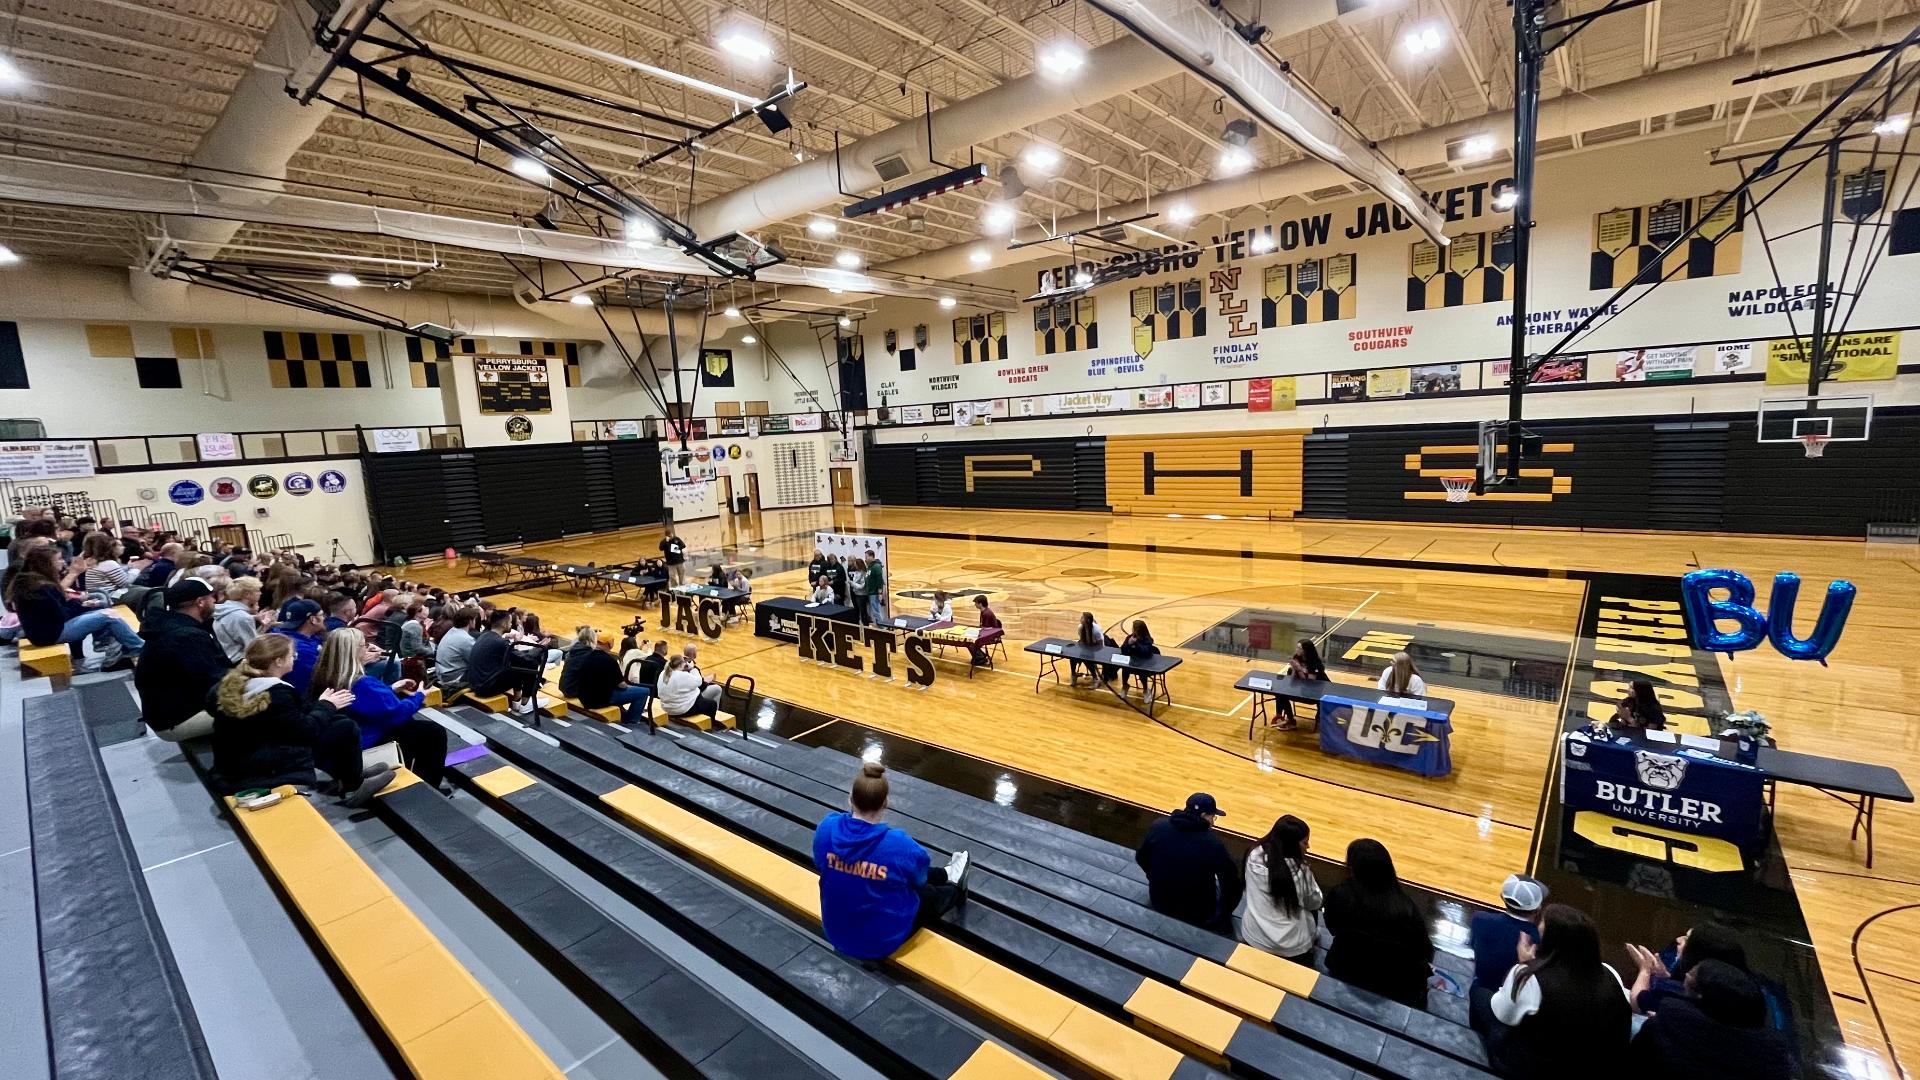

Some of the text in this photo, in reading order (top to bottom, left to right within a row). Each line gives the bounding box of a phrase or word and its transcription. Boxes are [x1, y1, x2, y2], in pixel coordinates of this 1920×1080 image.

[1037, 241, 1199, 292] PERRURG
[1212, 213, 1332, 263] YELLOW
[1728, 297, 1834, 317] WILDCATS
[1496, 309, 1562, 327] ANHONY
[1348, 325, 1414, 342] SOUTHVIEW
[1213, 342, 1259, 355] FINDLAY
[1353, 337, 1408, 351] COUGARS
[1717, 343, 1751, 351] HOME
[1772, 335, 1893, 352] JACKE FNS ARE
[1091, 355, 1140, 367] SPRINGFIELD
[1213, 353, 1259, 365] TROJANS
[1645, 358, 1677, 366] WITHOUT
[997, 365, 1049, 377] BOWLING GREEN
[1087, 364, 1144, 376] BLUE DEVILS
[1493, 364, 1511, 374] HOM
[928, 374, 960, 384] NORTHVIEW
[1008, 374, 1038, 384] BOBCATS
[1332, 375, 1366, 384] BUILDING
[1332, 381, 1360, 389] BETTER
[931, 382, 958, 391] WILDCATS
[877, 389, 899, 397] EAGLES
[1063, 392, 1112, 407] Jacket Way
[1595, 779, 1724, 825] BUTLER
[1611, 804, 1702, 829] UNIVERSITY
[826, 852, 889, 881] THOMAS
